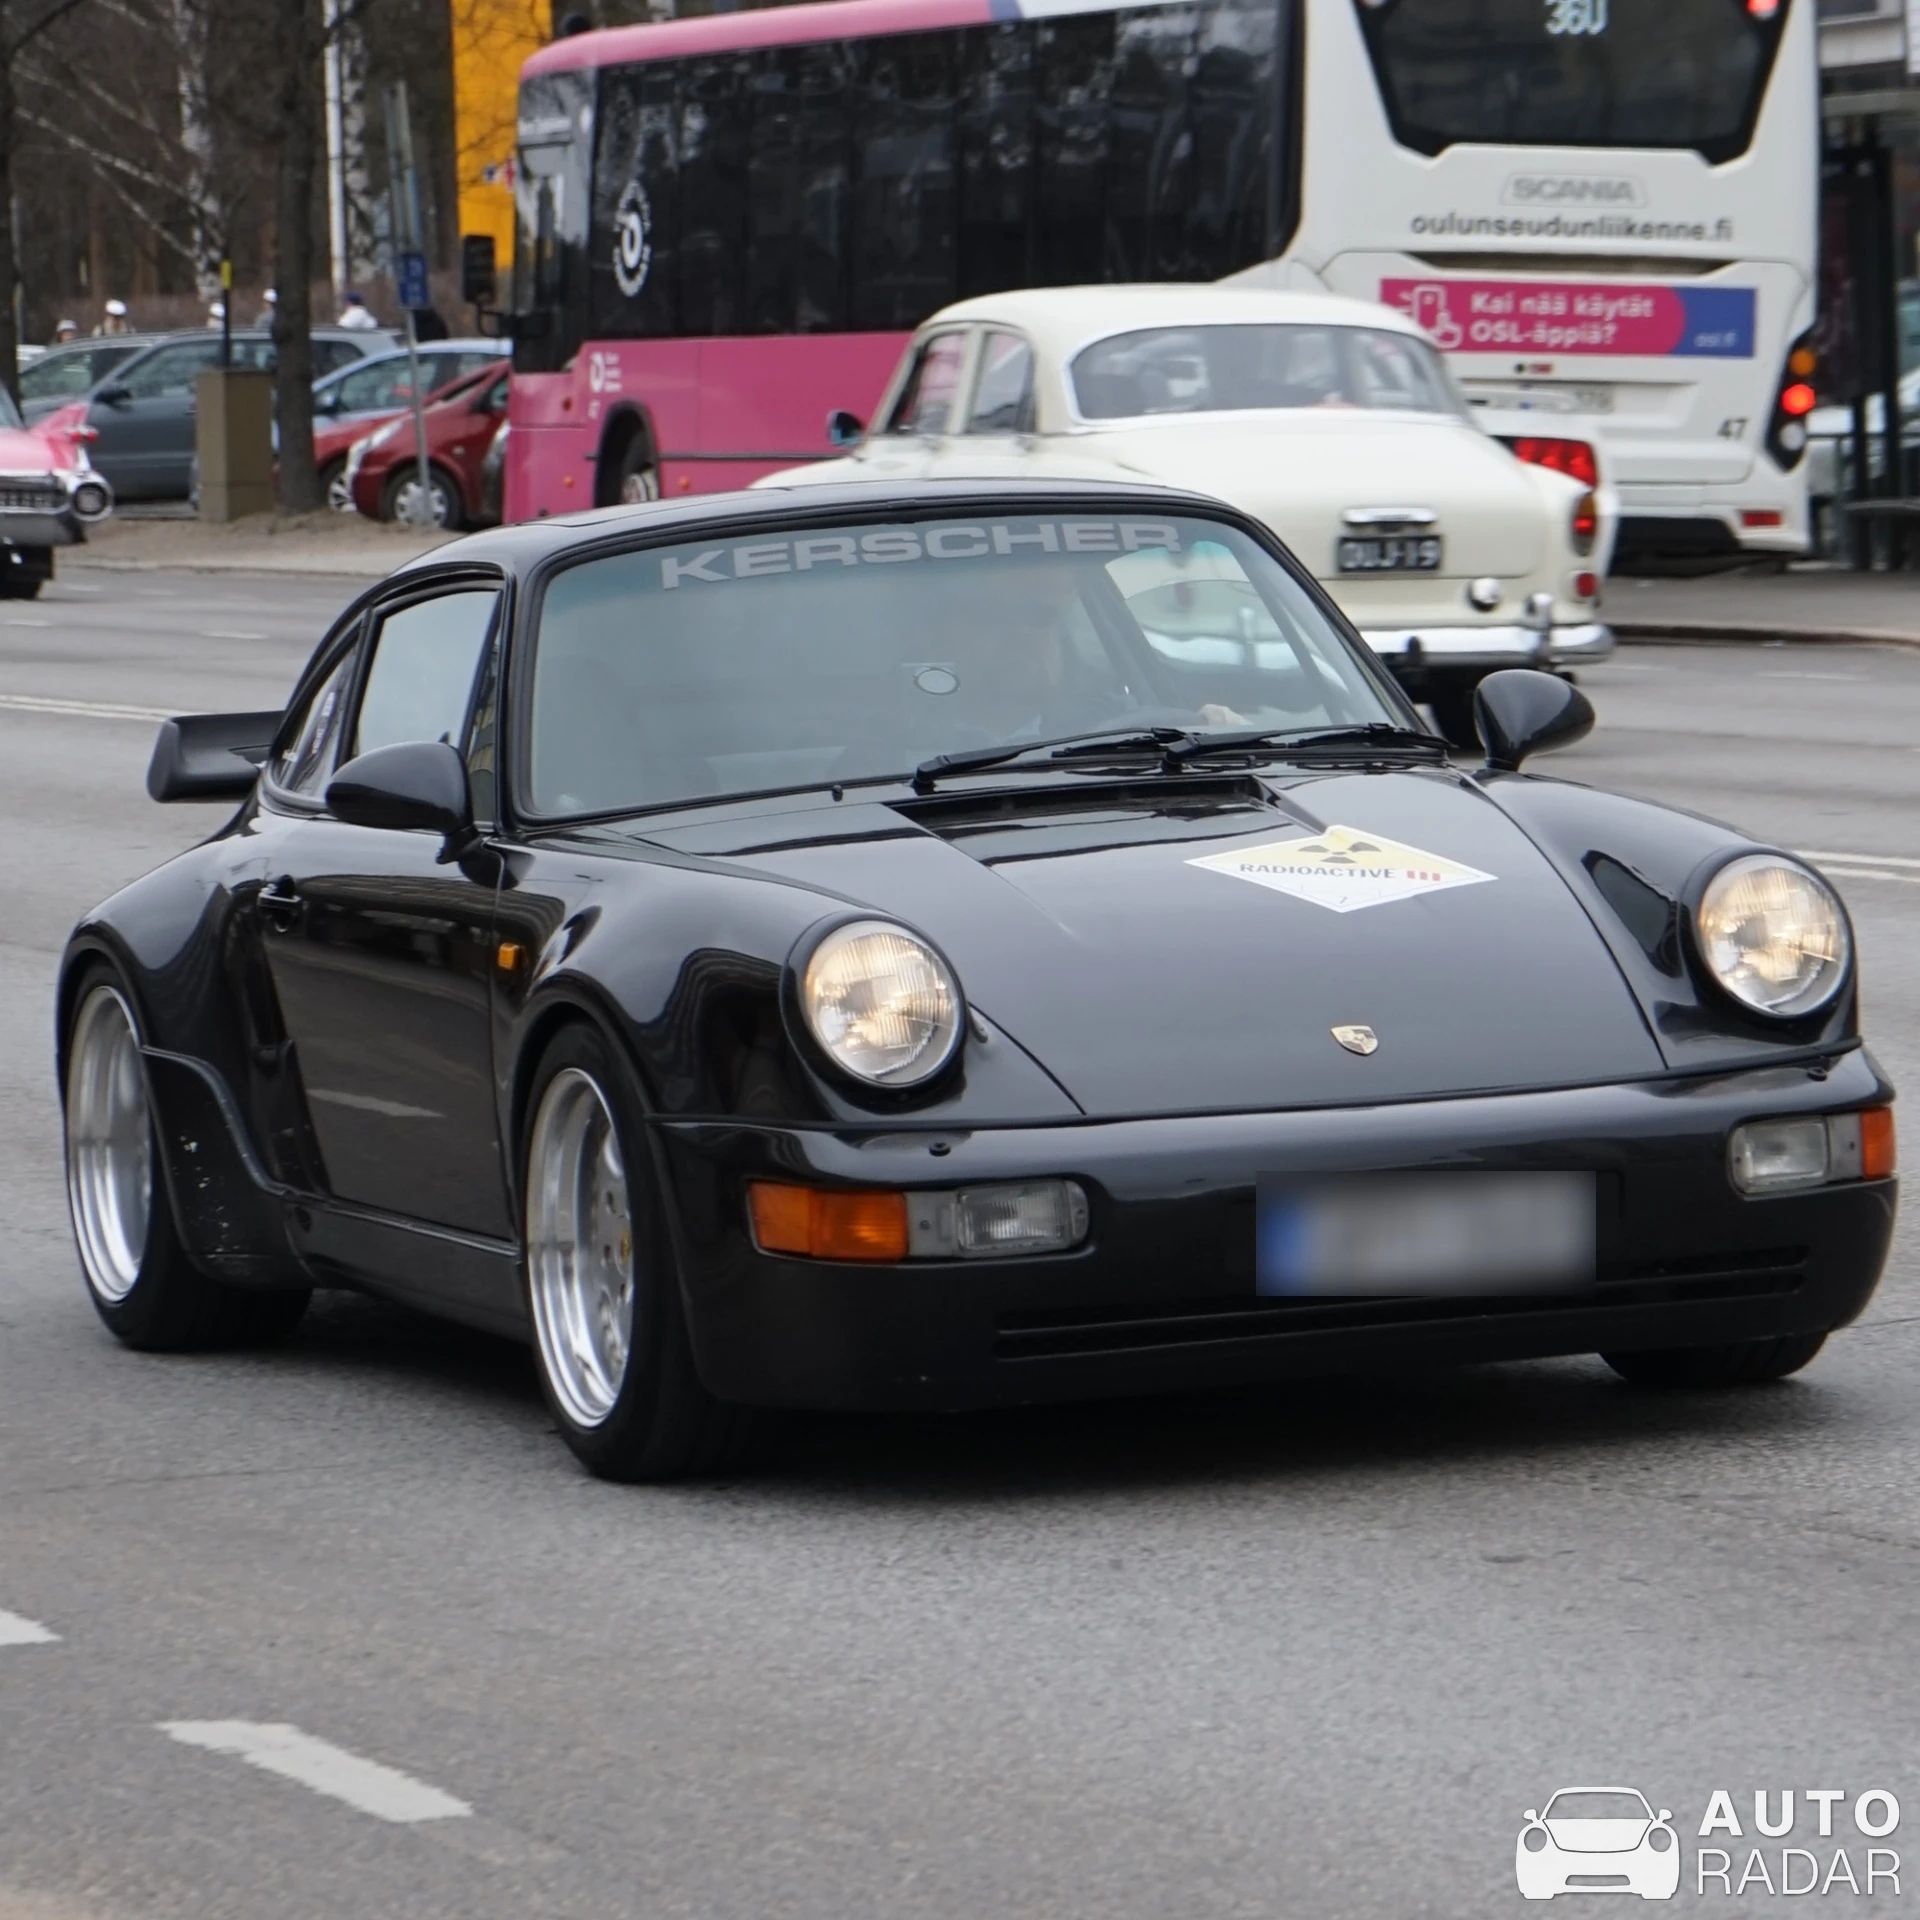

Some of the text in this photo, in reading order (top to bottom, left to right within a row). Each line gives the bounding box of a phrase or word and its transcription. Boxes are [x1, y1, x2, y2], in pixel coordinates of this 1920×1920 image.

[1512, 176, 1635, 203] SCANIA
[1411, 212, 1733, 241] oulunseudunliikenne.fi
[1471, 291, 1514, 314] Kai
[1574, 293, 1655, 320] käytät
[1469, 320, 1618, 348] OSL-äppiä?
[1717, 418, 1747, 440] 47
[661, 522, 1182, 590] KERSCHER
[1239, 863, 1396, 879] RADIOACTIVE
